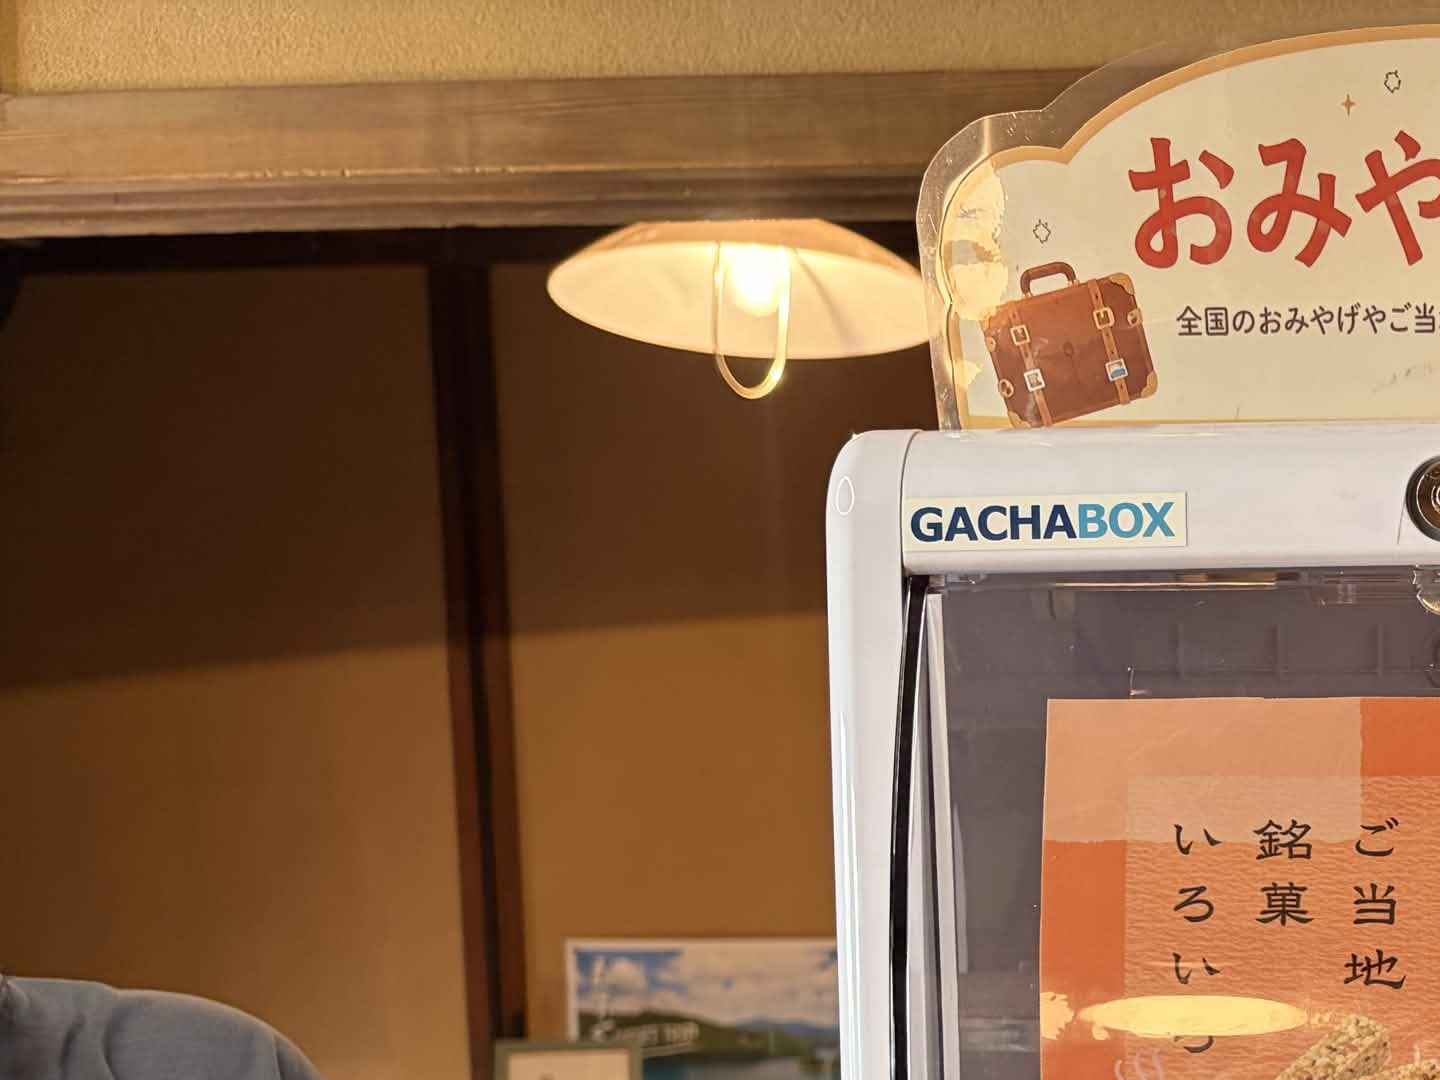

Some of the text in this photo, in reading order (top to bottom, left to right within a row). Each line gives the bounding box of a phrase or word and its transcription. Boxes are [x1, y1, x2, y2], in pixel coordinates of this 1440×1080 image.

[909, 501, 1175, 543] GACHABOX
[1252, 818, 1315, 927] 銘菓
[1343, 816, 1407, 990] ご当地
